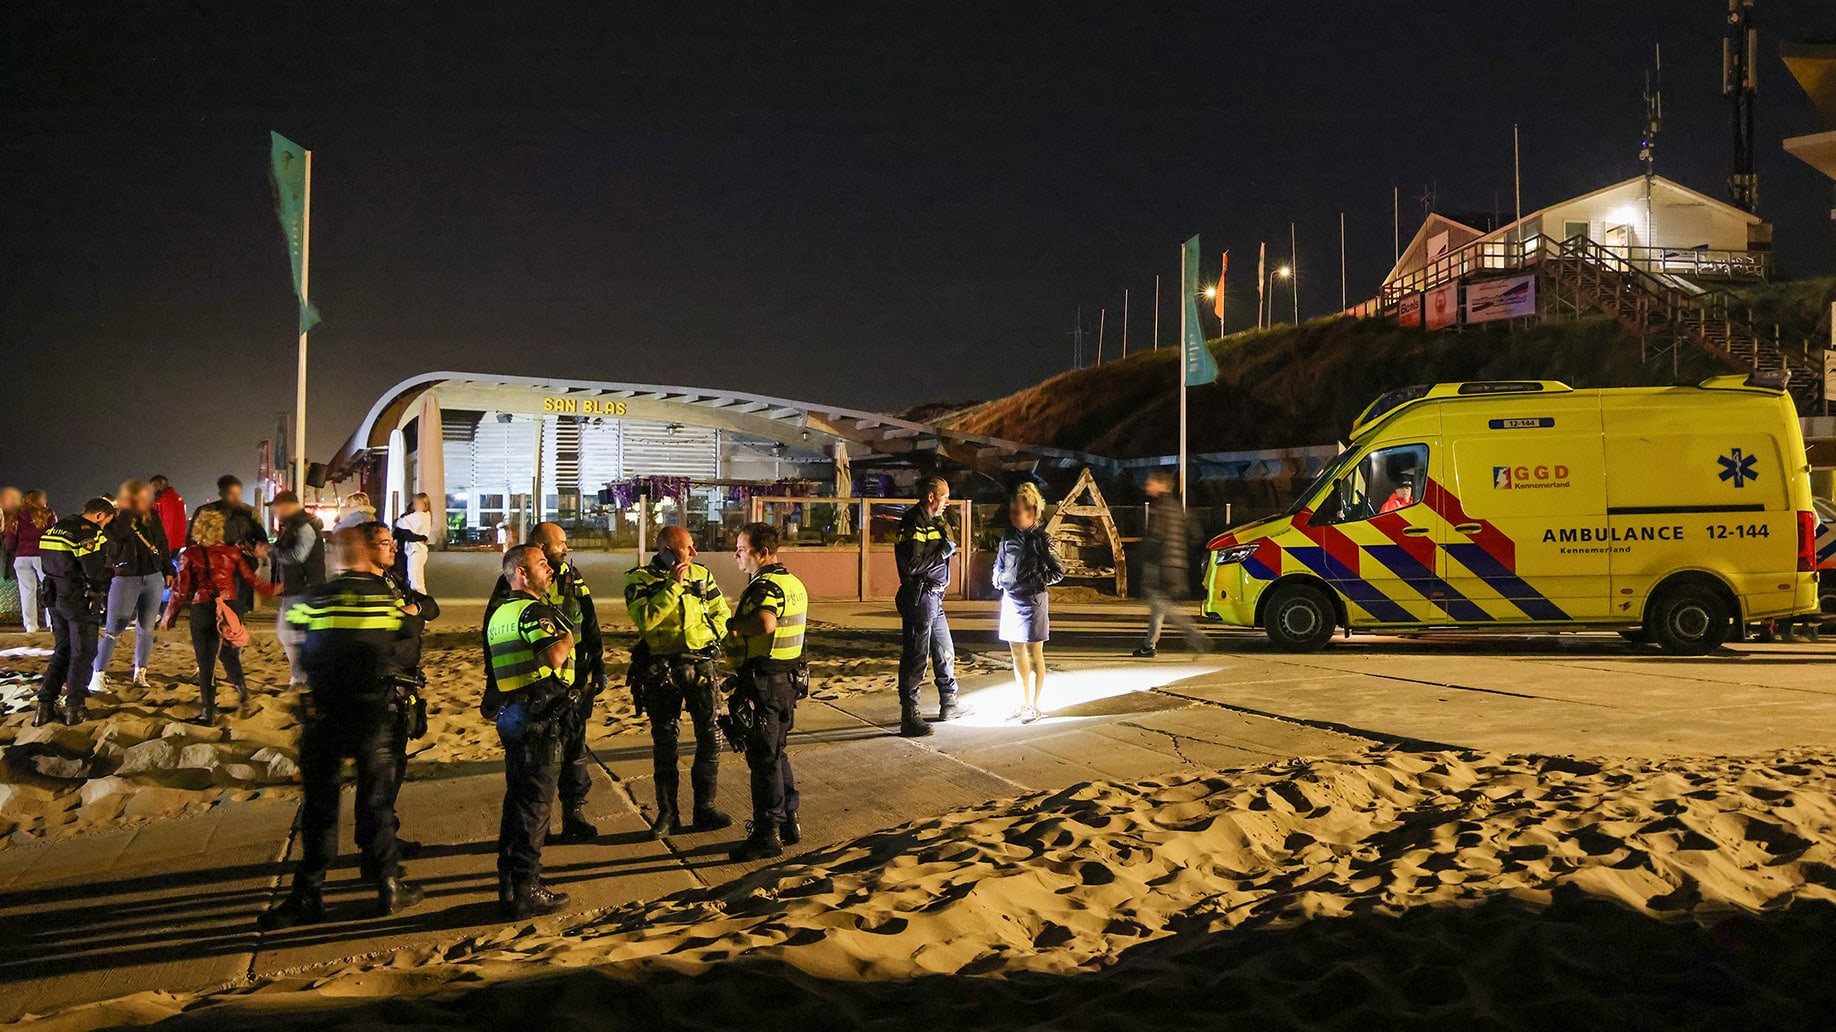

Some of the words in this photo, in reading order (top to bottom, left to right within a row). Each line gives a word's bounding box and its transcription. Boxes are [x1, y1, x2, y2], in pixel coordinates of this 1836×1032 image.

[543, 397, 577, 413] SAN
[582, 400, 627, 416] BLAS
[1514, 481, 1570, 489] Kennemerland
[1542, 526, 1684, 543] AMBULANCE
[1706, 524, 1770, 539] 12-144
[1560, 546, 1631, 554] Kennemerland
